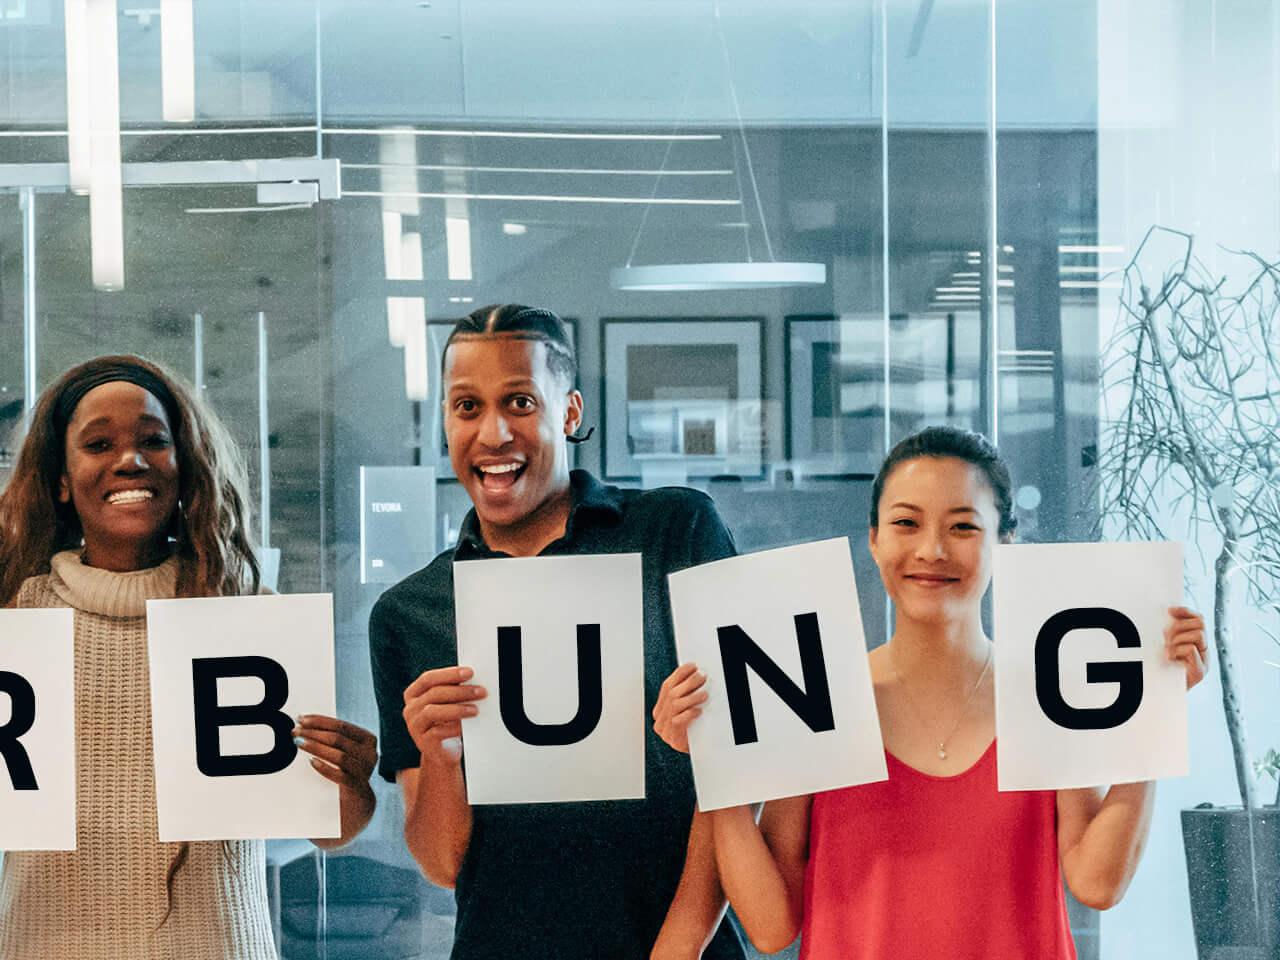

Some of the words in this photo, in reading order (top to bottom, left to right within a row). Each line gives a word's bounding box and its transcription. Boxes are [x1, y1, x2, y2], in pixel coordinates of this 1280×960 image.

[191, 655, 299, 778] B
[497, 623, 603, 746] U
[716, 611, 836, 746] N
[1034, 607, 1144, 730] G
